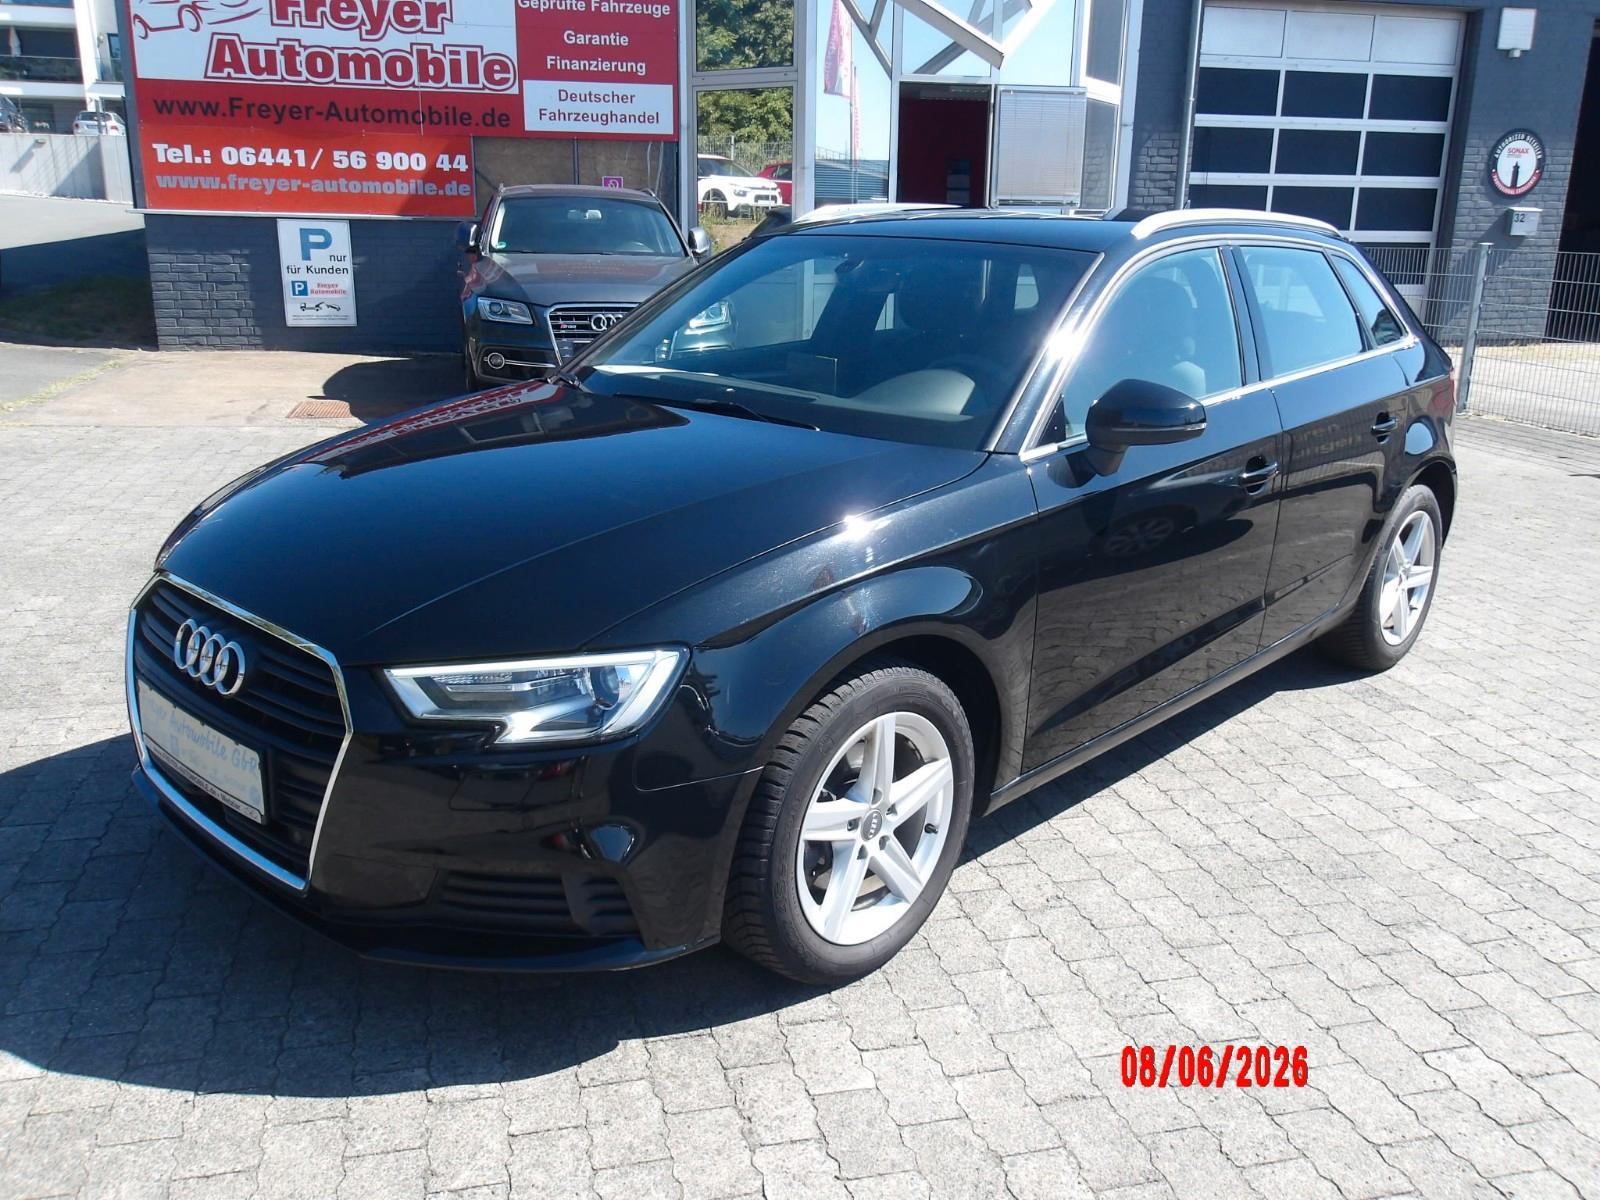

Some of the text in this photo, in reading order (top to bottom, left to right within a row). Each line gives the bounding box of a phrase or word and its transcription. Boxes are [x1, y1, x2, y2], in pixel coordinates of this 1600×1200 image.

[591, 0, 671, 18] Fahrzeuge
[563, 30, 629, 46] Garantie
[205, 33, 515, 91] Automobile
[546, 56, 646, 75] Finanzierung
[558, 89, 636, 104] Deutscher
[154, 97, 510, 128] www.Freyer-Automobile.de
[539, 108, 659, 126] Fahrzeughandel
[152, 143, 212, 164] Tel.:
[333, 151, 367, 169] 56
[376, 151, 427, 171] 900
[436, 154, 468, 172] 44
[156, 174, 471, 196] www.freyer-automobile.de
[1514, 213, 1525, 222] 32
[299, 228, 333, 261] P
[286, 265, 349, 275] für Kunden
